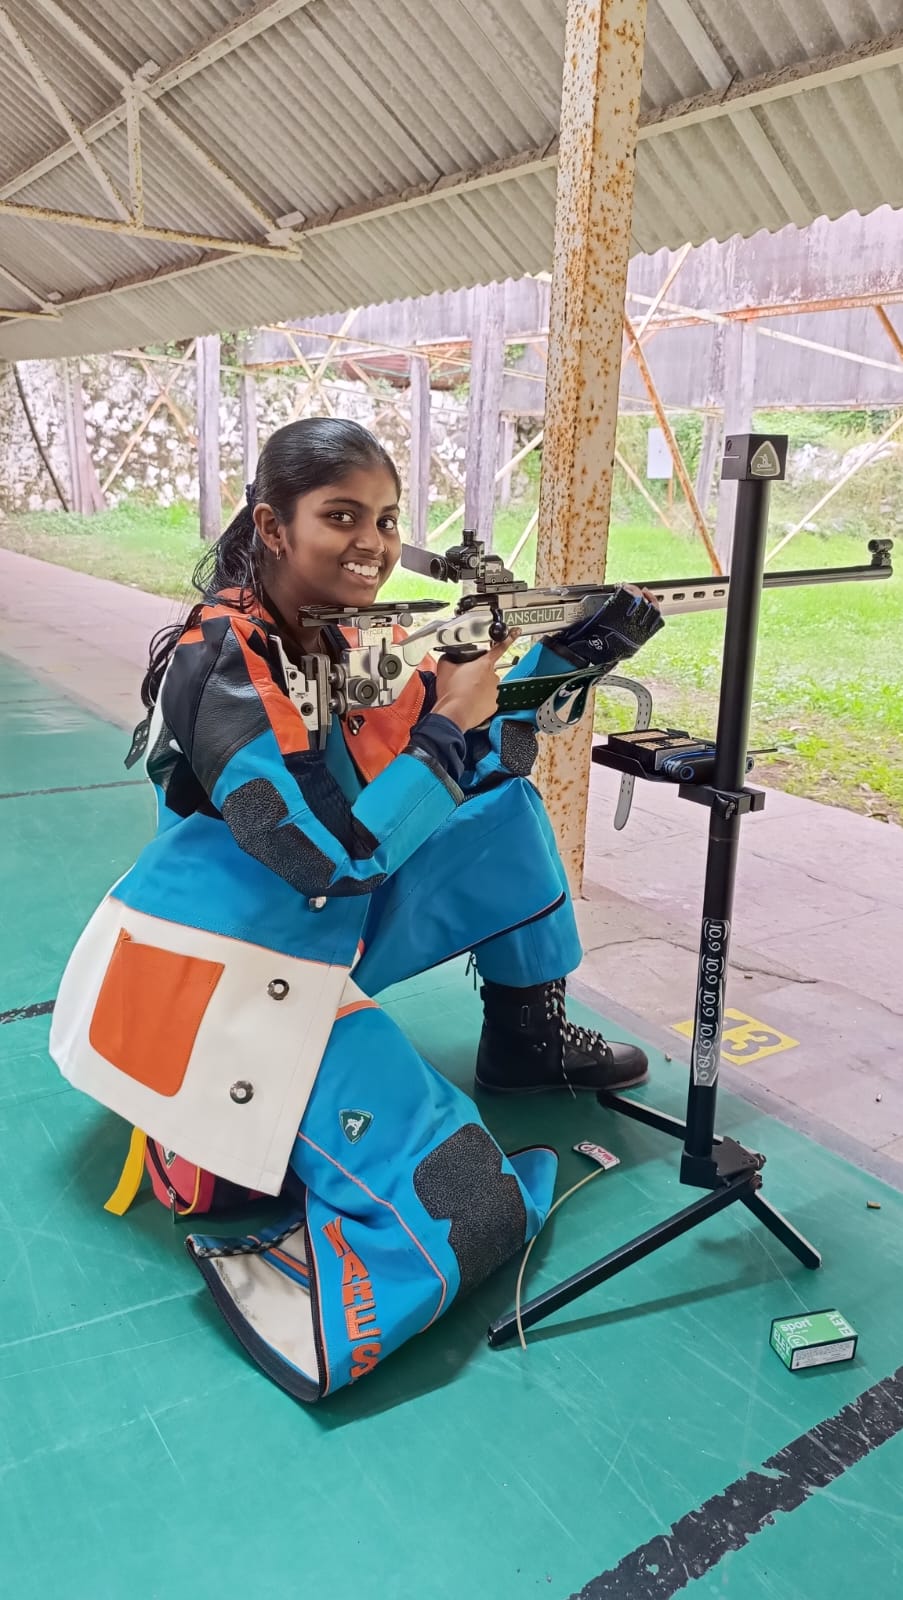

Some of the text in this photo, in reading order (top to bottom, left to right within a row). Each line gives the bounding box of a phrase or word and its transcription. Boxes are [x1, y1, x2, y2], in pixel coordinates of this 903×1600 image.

[506, 607, 563, 625] ANSCHUTZ
[708, 924, 722, 952] 10.9
[705, 958, 719, 985] 10.9
[702, 990, 716, 1017] 10.9
[700, 1023, 714, 1049] 10.9
[321, 1216, 381, 1378] KARES
[780, 1318, 813, 1334] sport
